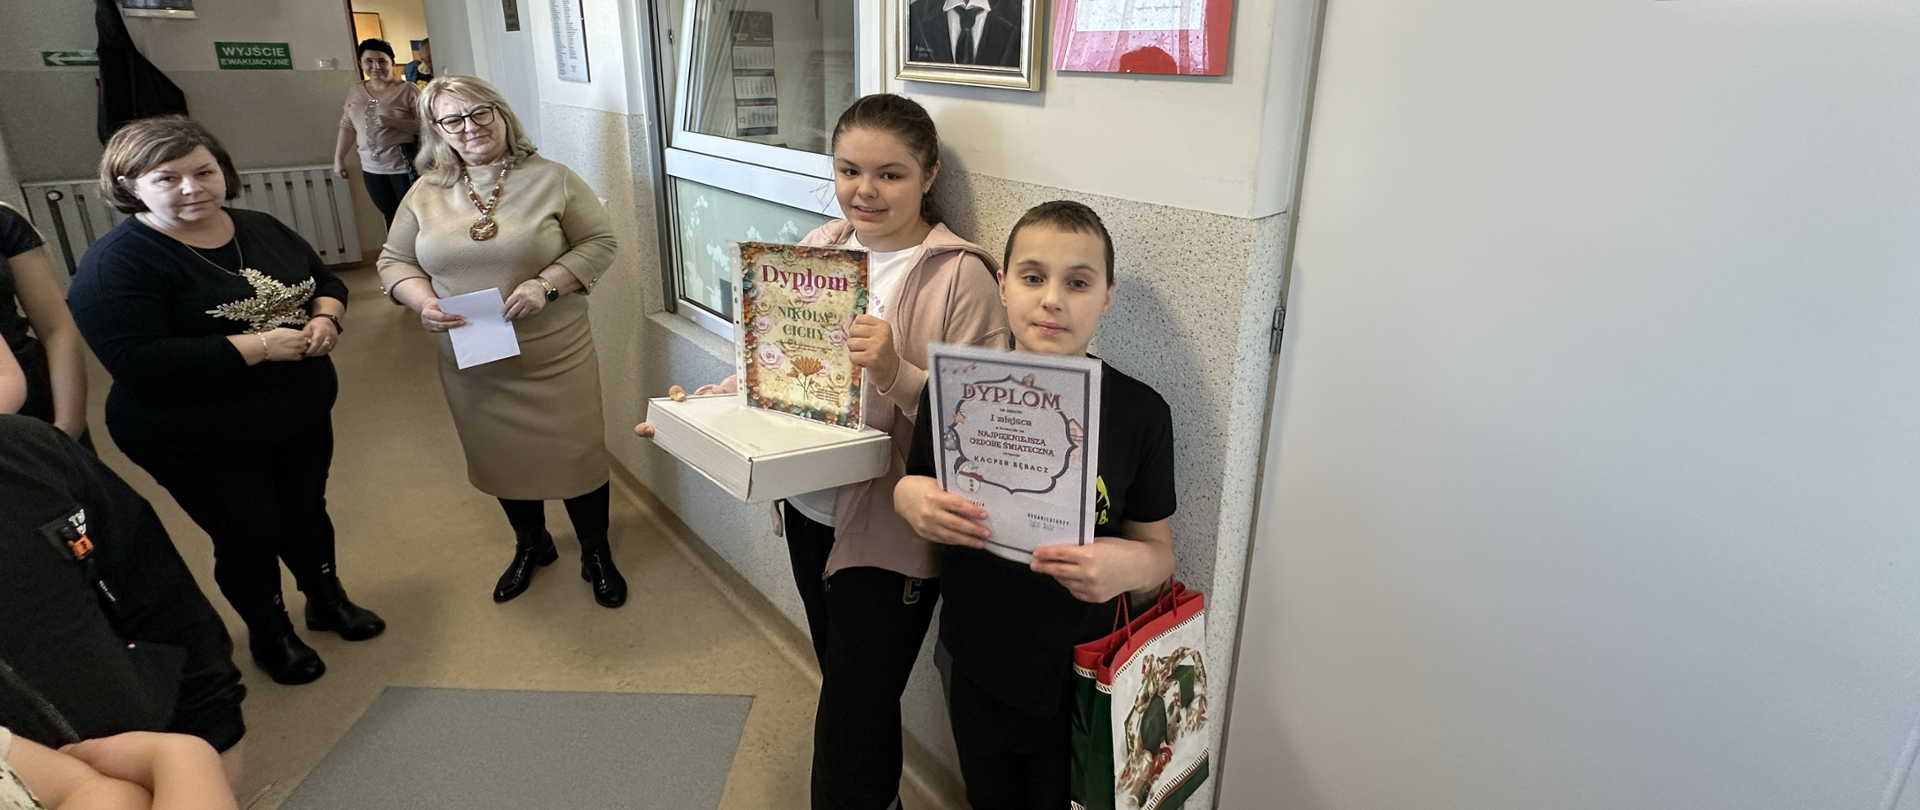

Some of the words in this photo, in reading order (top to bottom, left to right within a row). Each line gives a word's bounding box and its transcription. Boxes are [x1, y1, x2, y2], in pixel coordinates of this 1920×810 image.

[221, 45, 285, 57] WYJŚCIE
[220, 58, 291, 66] EWAKUACYJNE
[761, 264, 848, 292] Dyplom
[777, 305, 830, 324] NIKOLA
[782, 325, 826, 340] CICHY
[962, 383, 1063, 410] DYPLOM
[997, 416, 1033, 427] miejsca
[973, 455, 1010, 467] KACPER
[1013, 461, 1050, 474] BĘBACZ
